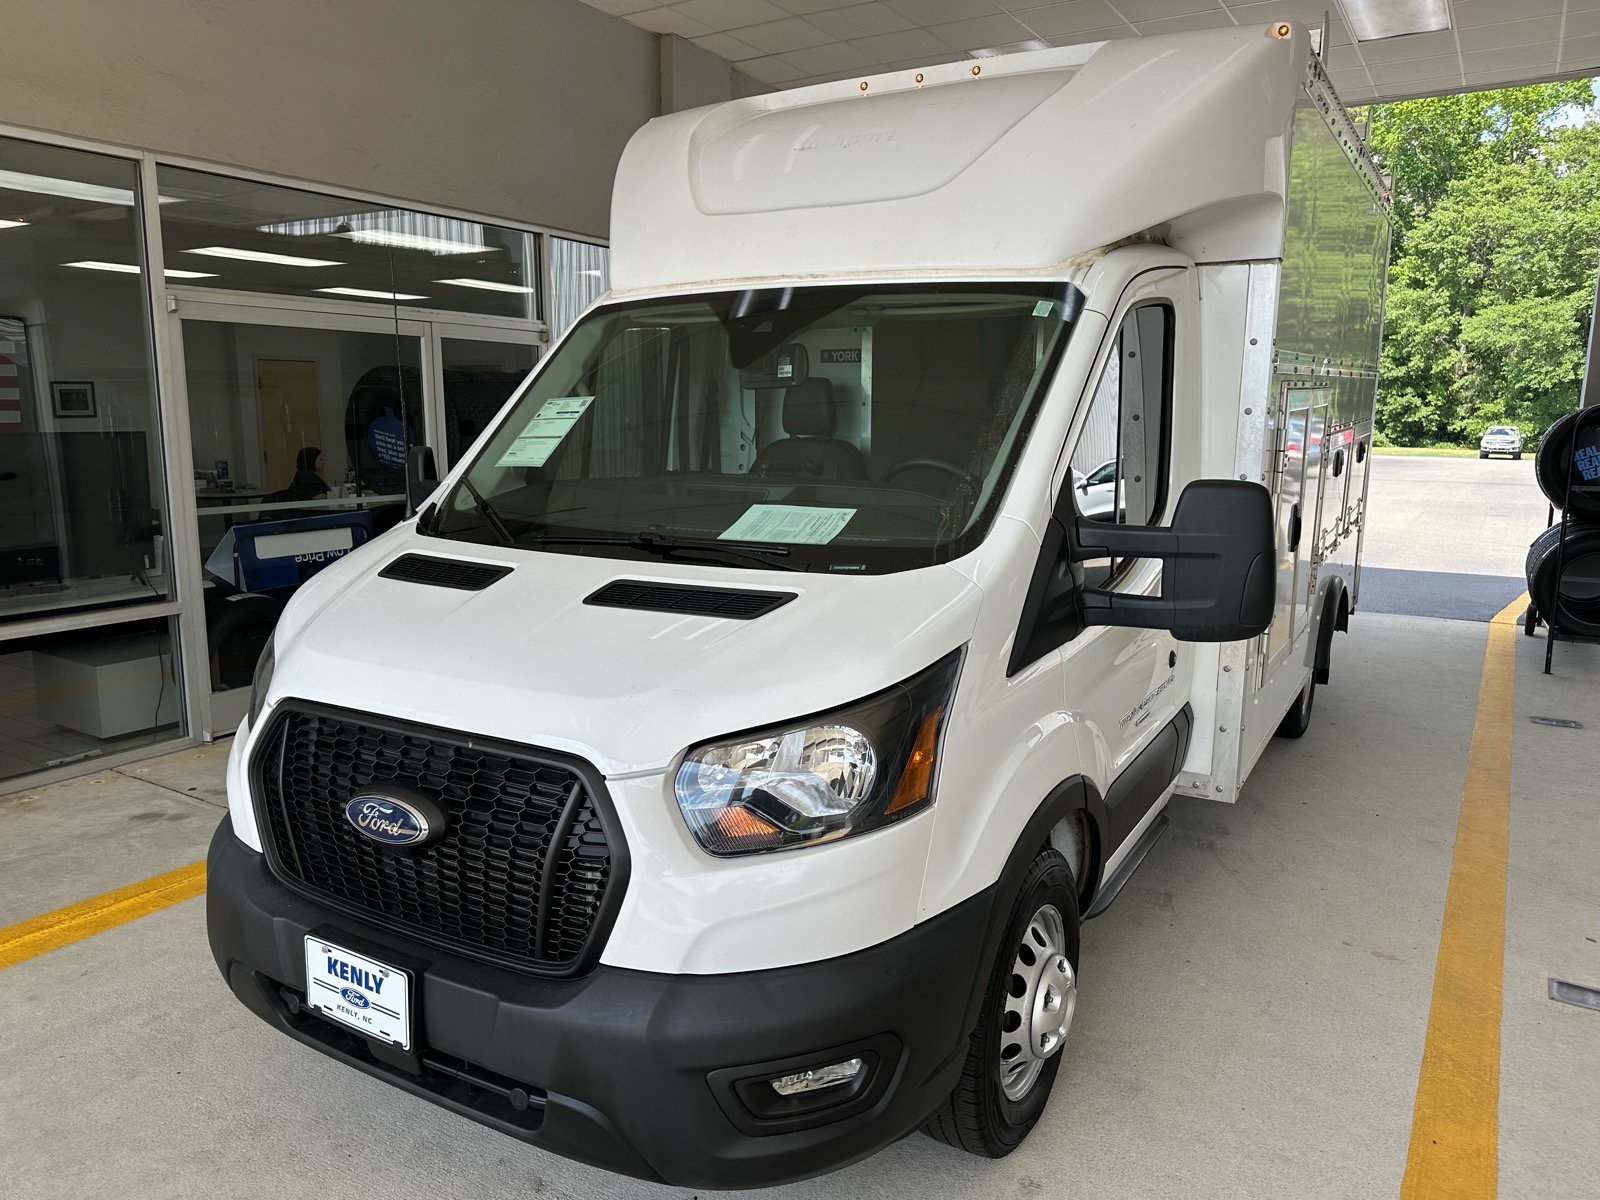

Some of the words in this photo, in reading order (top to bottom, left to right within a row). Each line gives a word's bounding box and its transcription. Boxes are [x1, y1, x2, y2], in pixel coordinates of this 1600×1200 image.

[831, 351, 859, 362] YORK
[295, 552, 325, 563] Price
[358, 803, 404, 836] Ford
[327, 956, 384, 995] KENLY
[345, 990, 366, 1007] Ford
[362, 1015, 373, 1025] NC
